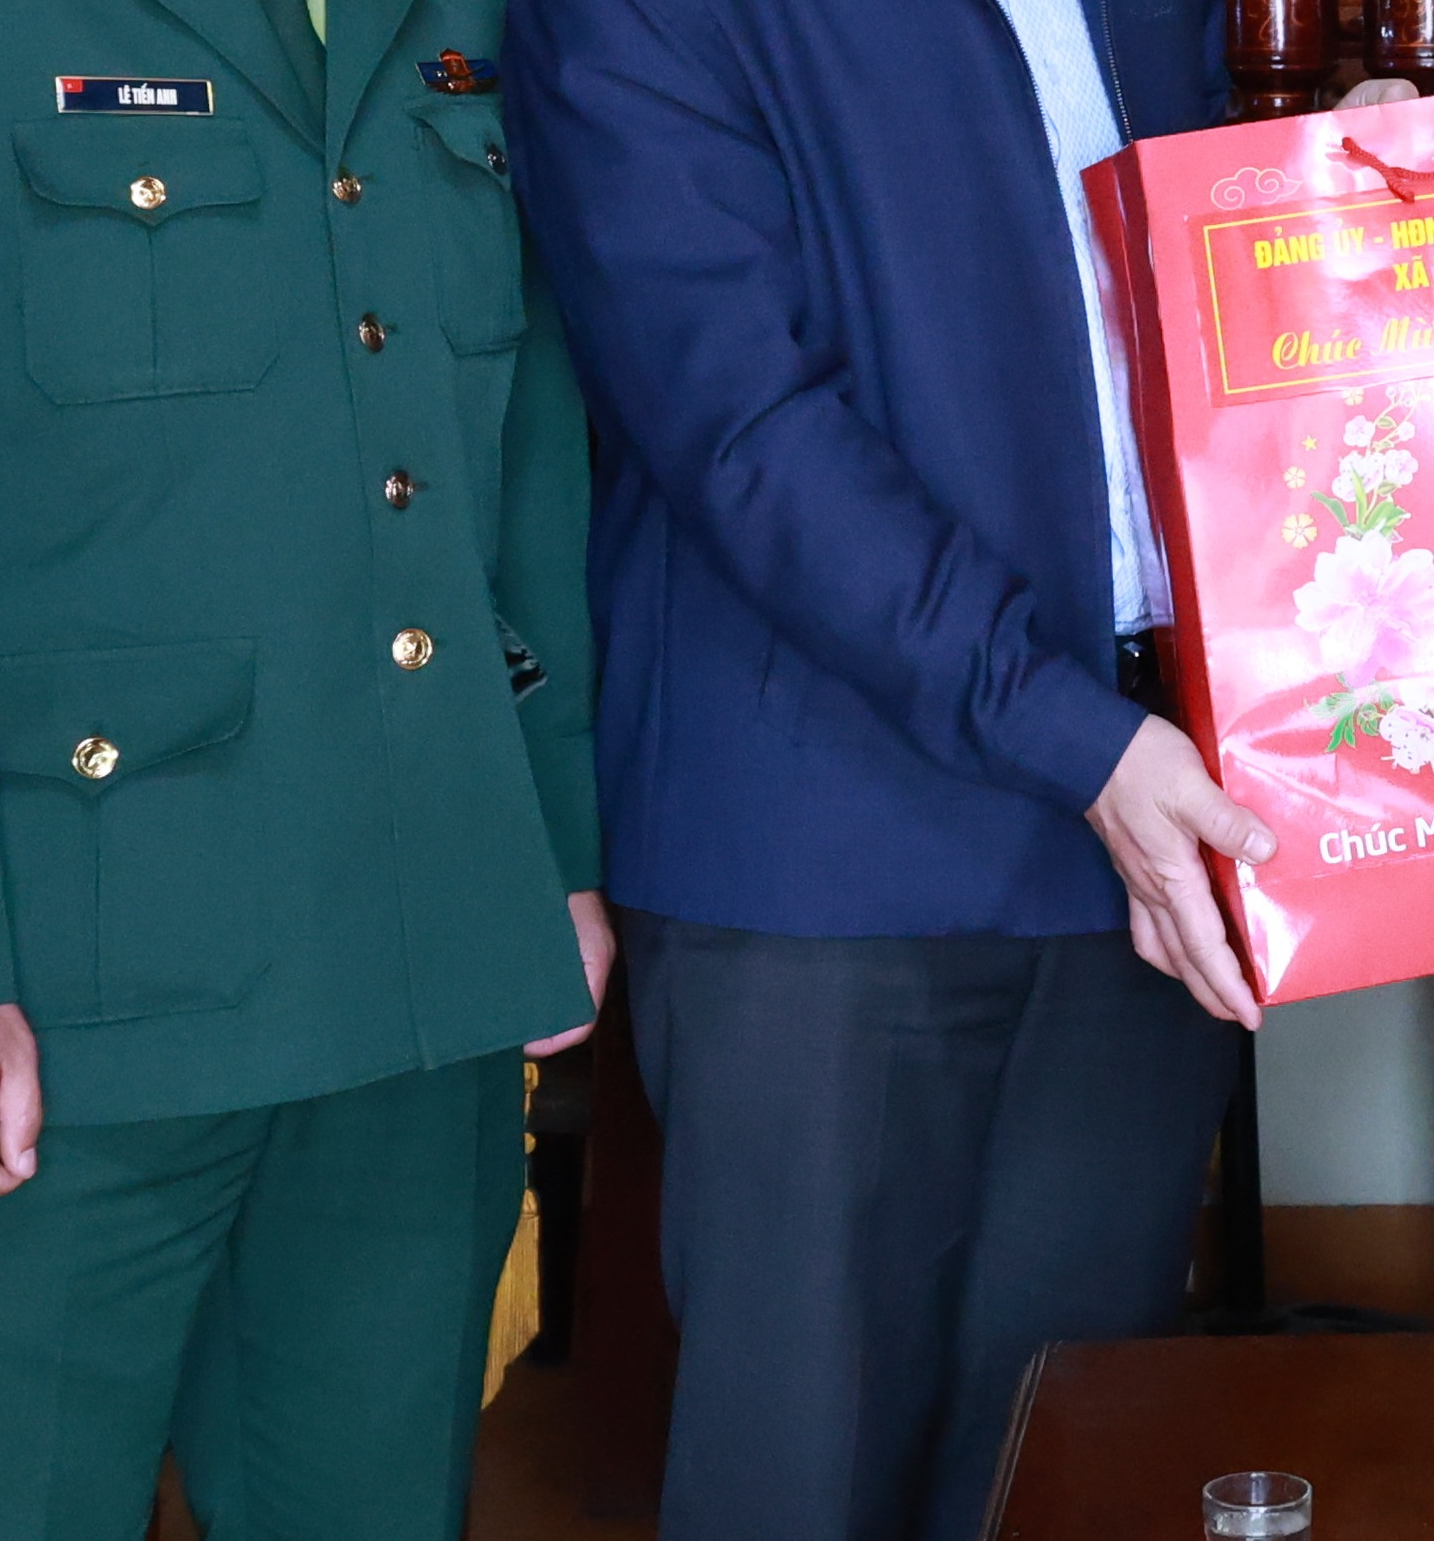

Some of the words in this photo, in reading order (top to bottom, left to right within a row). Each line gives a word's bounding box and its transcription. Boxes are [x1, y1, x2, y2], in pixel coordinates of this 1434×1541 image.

[1253, 225, 1326, 270] ĐẢNG
[1391, 254, 1431, 292] XÃ
[1271, 328, 1363, 370] Chúc
[1318, 821, 1408, 865] Chúc
